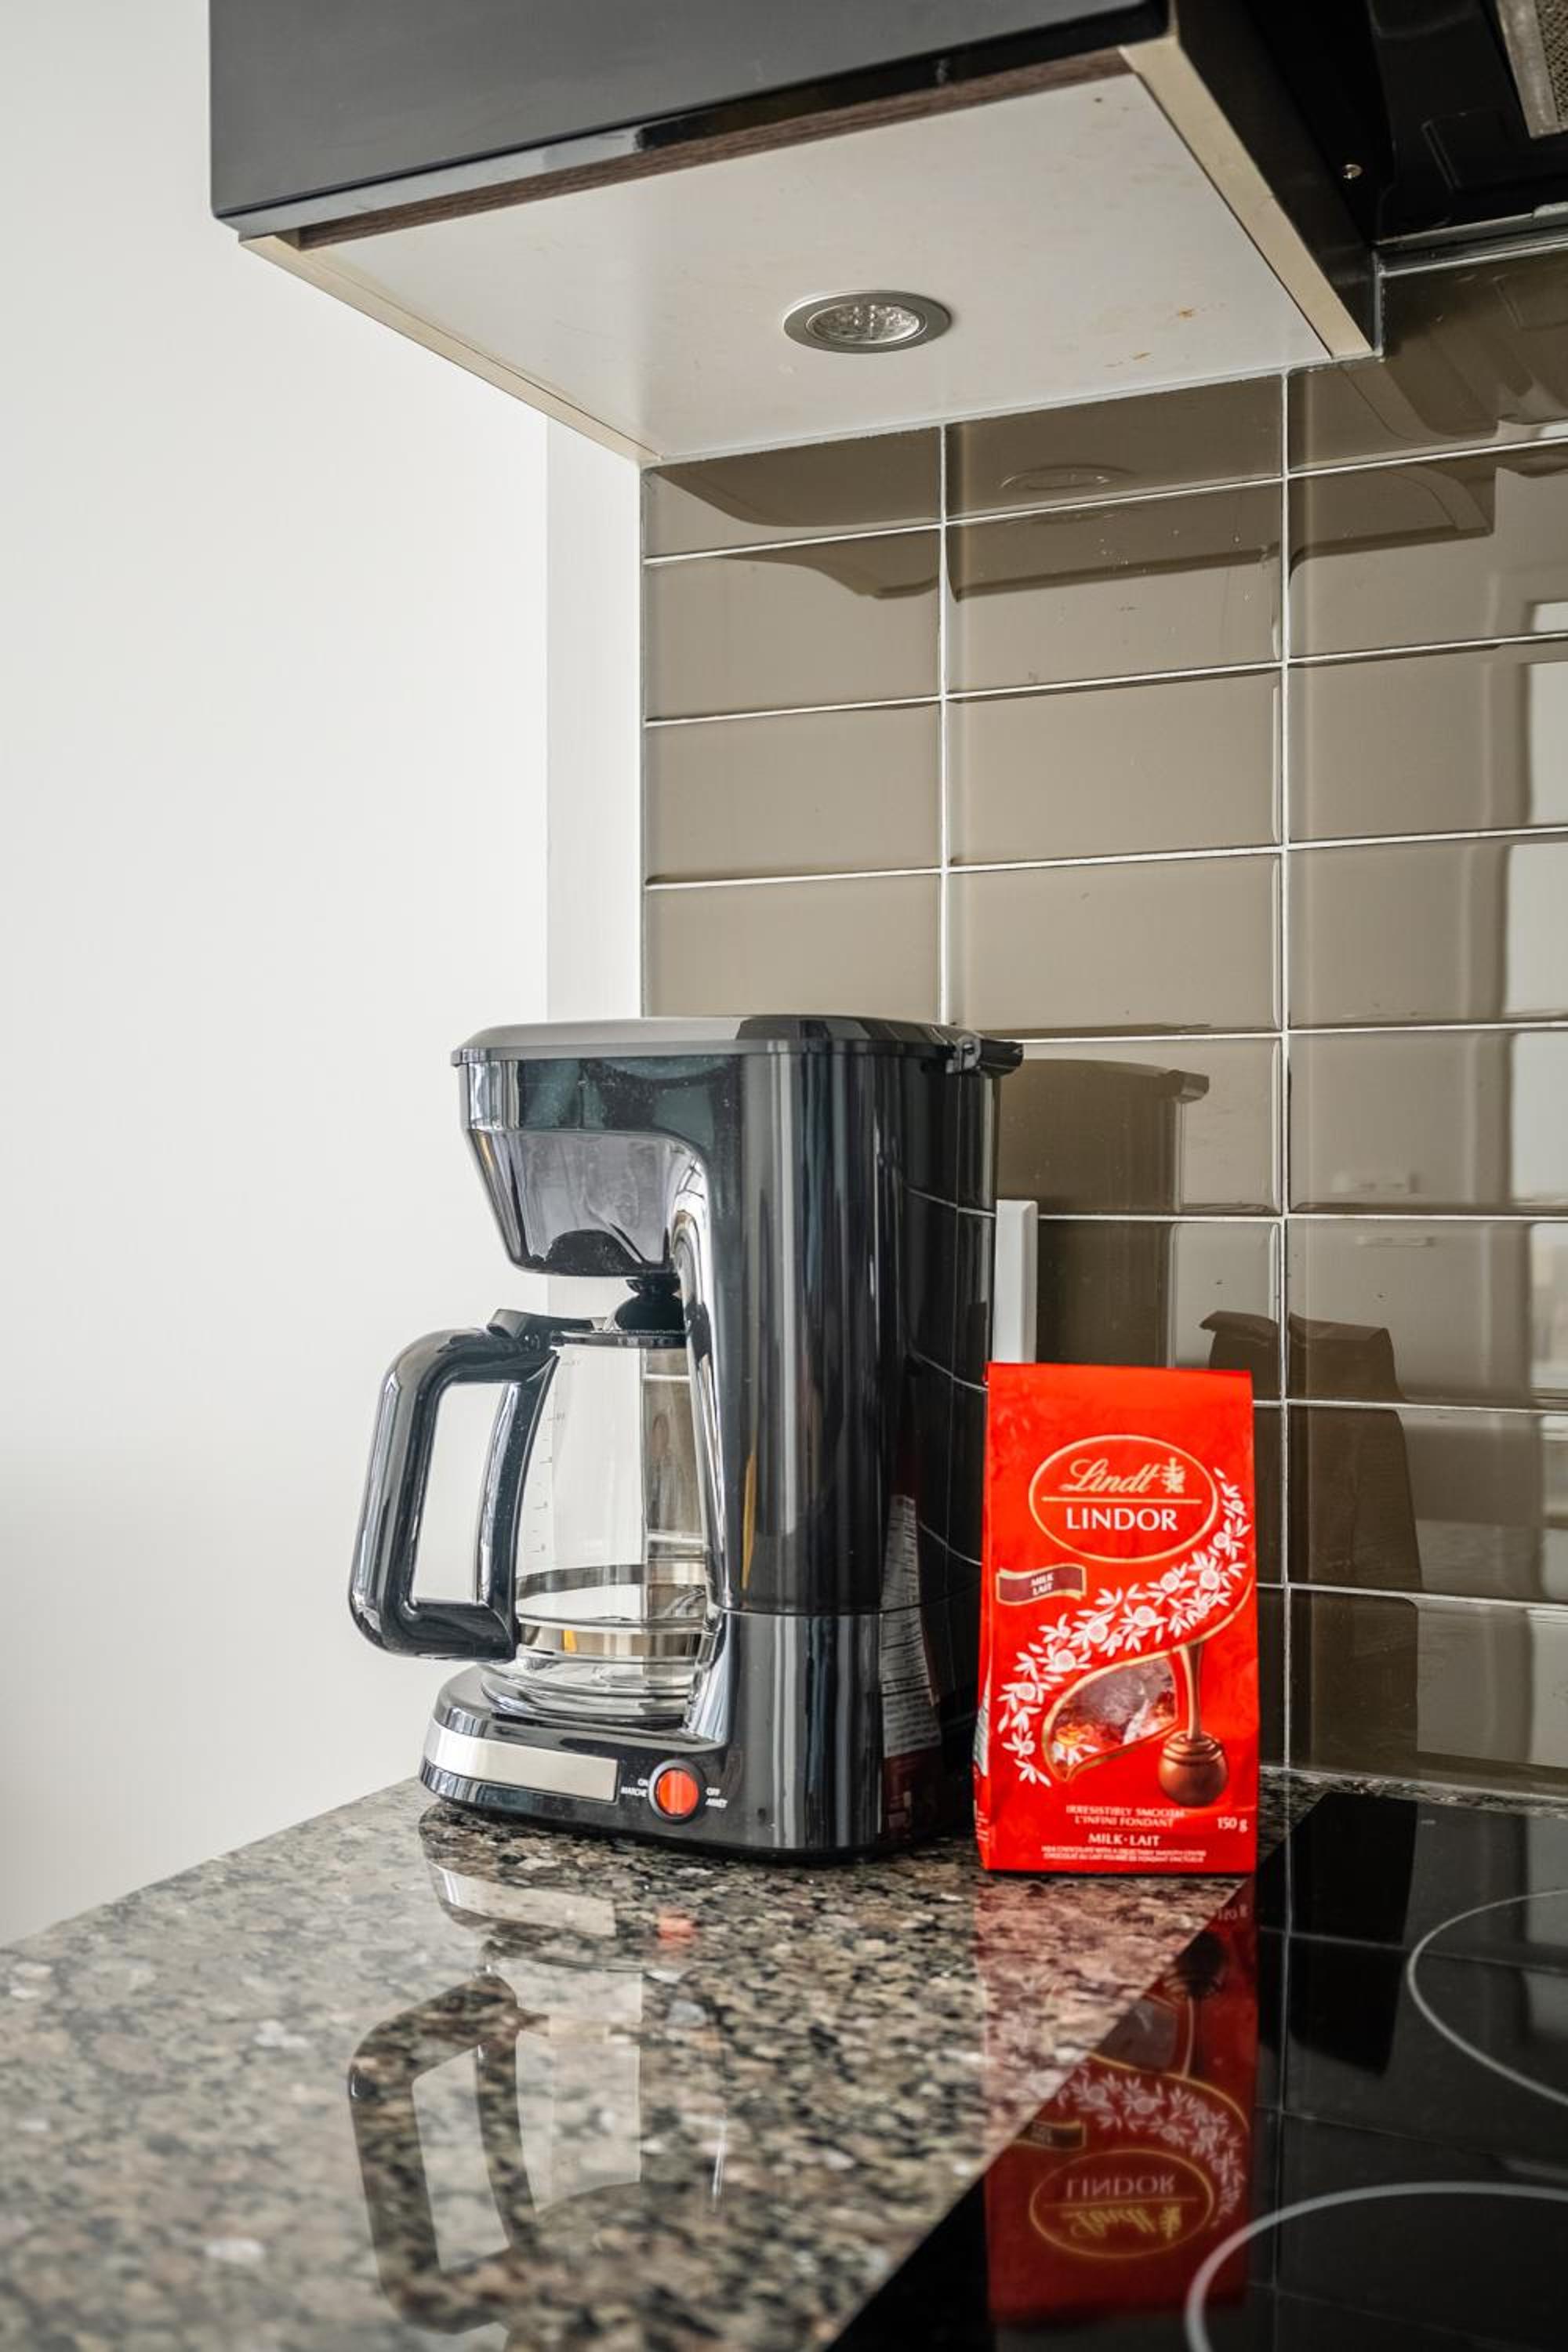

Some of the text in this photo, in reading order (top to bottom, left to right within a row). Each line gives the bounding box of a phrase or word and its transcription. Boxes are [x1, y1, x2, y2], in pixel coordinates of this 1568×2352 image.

[1060, 1458, 1160, 1493] Lindt
[1066, 1507, 1178, 1531] LINDOR
[706, 1787, 720, 1796] OFF
[1120, 1817, 1174, 1828] FONDANT
[1217, 1817, 1247, 1832] 150 g
[1087, 1833, 1160, 1846] MILK LAIT
